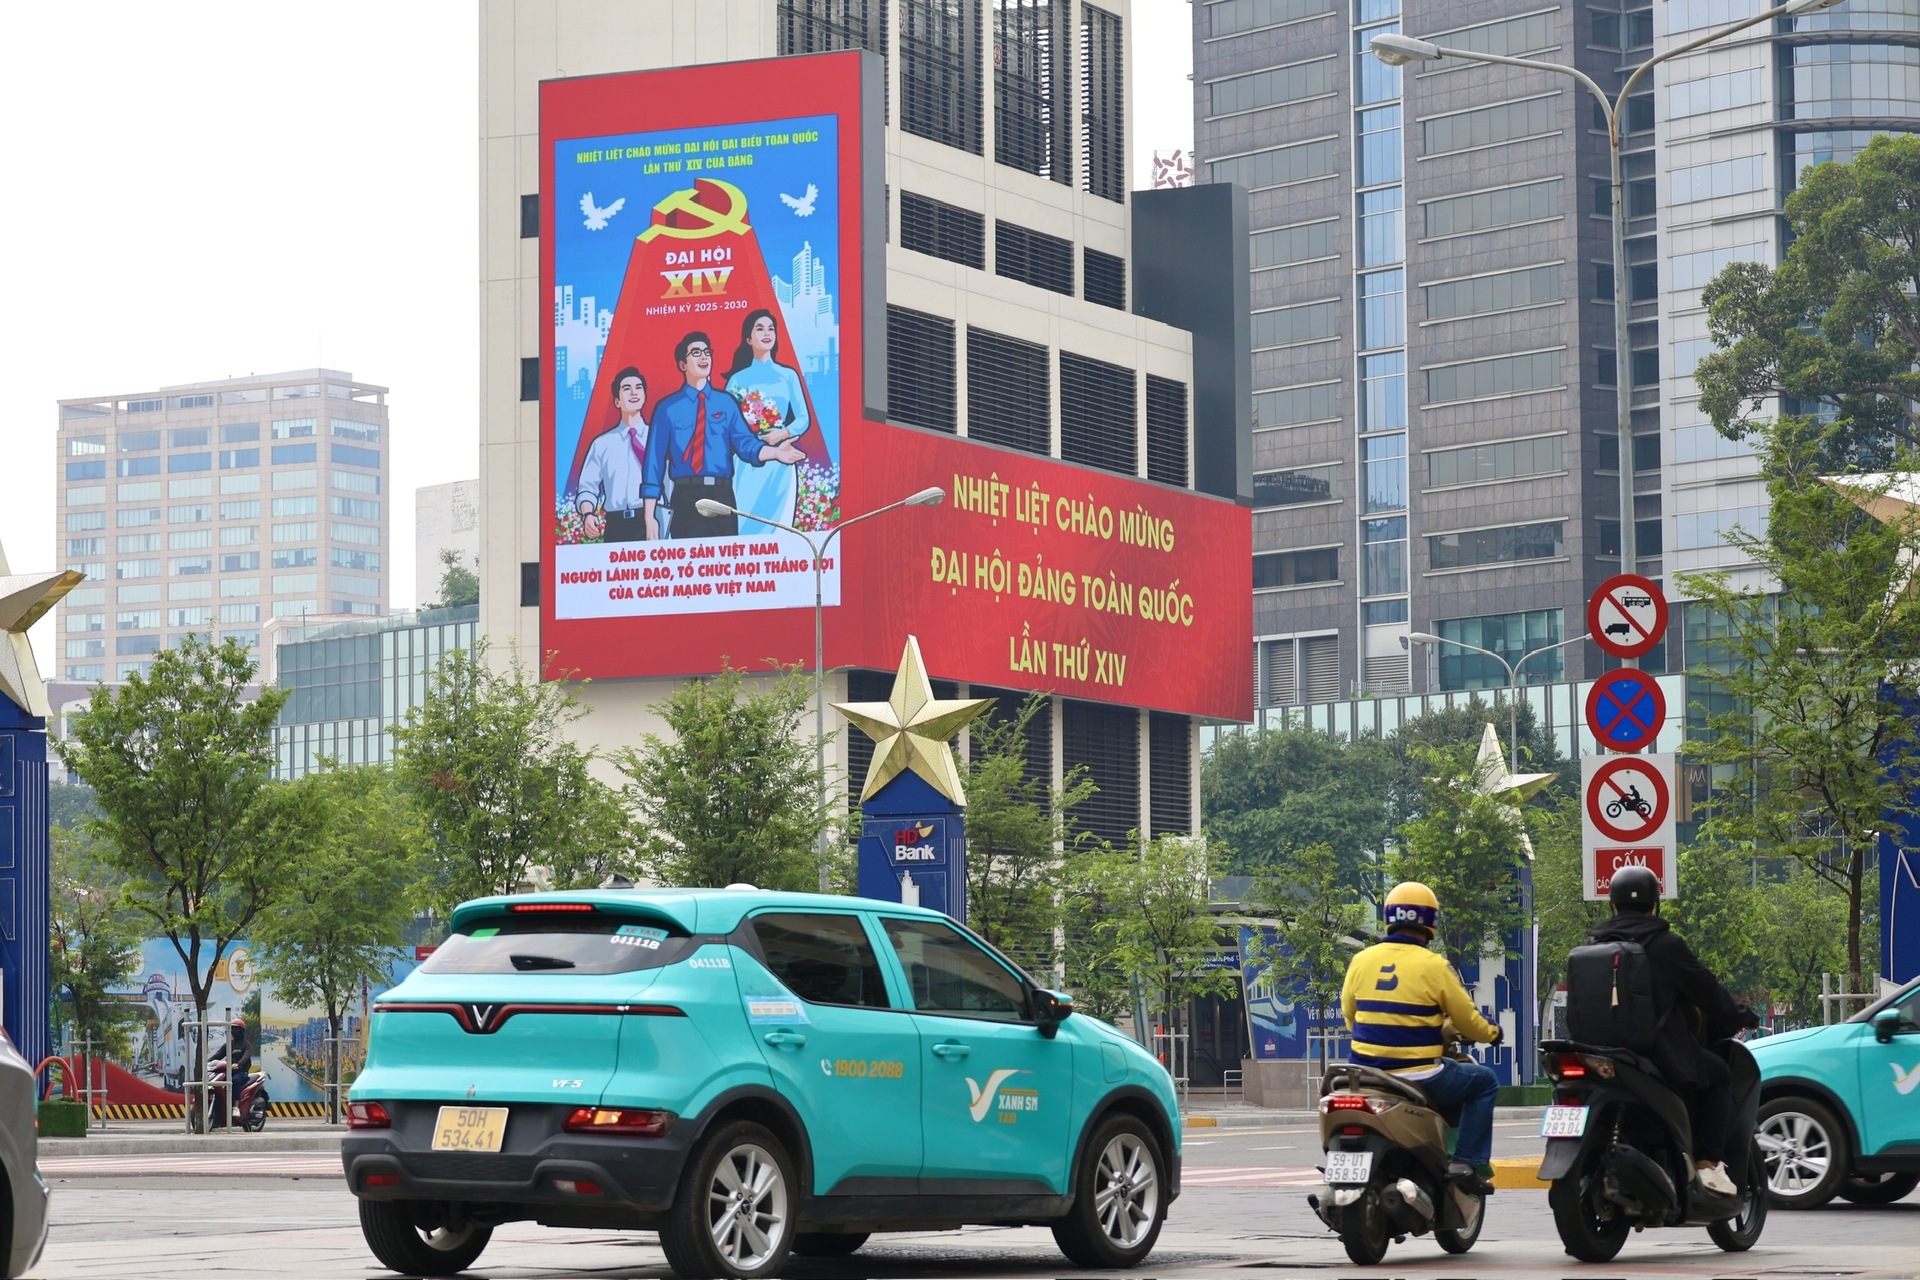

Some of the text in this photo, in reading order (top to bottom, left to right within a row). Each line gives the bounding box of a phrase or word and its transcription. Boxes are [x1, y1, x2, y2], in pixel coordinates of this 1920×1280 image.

[686, 157, 703, 171] XIV
[665, 245, 732, 267] ĐẠI HỘI
[660, 266, 734, 299] XIV
[646, 304, 676, 316] NHIỆM
[694, 302, 718, 312] 2025
[724, 300, 748, 310] 2030
[953, 471, 1175, 552] NHIỆT LIỆT CHÀO MỪNG
[650, 545, 686, 563] CỘNG
[718, 542, 745, 559] VIỆT
[749, 542, 779, 556] NAM
[560, 567, 602, 584] NGƯỜI
[643, 566, 674, 582] ĐẠO,
[698, 561, 731, 577] CHỨC
[734, 561, 760, 578] MỌI
[608, 579, 776, 600] CỦA CÁCH MẠNG VIỆT NAM
[931, 546, 1194, 627] ĐẠI HỘI ĐẢNG TOÀN QUỐC
[1009, 620, 1127, 687] LẦN THỨ XIV
[895, 829, 919, 845] HD
[895, 844, 936, 861] Bank
[1612, 849, 1647, 871] CẤM
[1596, 876, 1610, 889] CÁC
[640, 928, 661, 937] TAXI
[610, 935, 661, 950] 04111B
[689, 958, 731, 969] 04111B
[835, 1059, 903, 1078] 1900 2088
[998, 1094, 1038, 1111] XANH SM
[457, 1110, 488, 1128] 50H
[1551, 1108, 1582, 1121] 59-E2
[1544, 1121, 1580, 1135] 283.04
[441, 1129, 494, 1148] 534.41
[1332, 1153, 1364, 1167] 59-U1
[1326, 1167, 1367, 1181] 958.50
